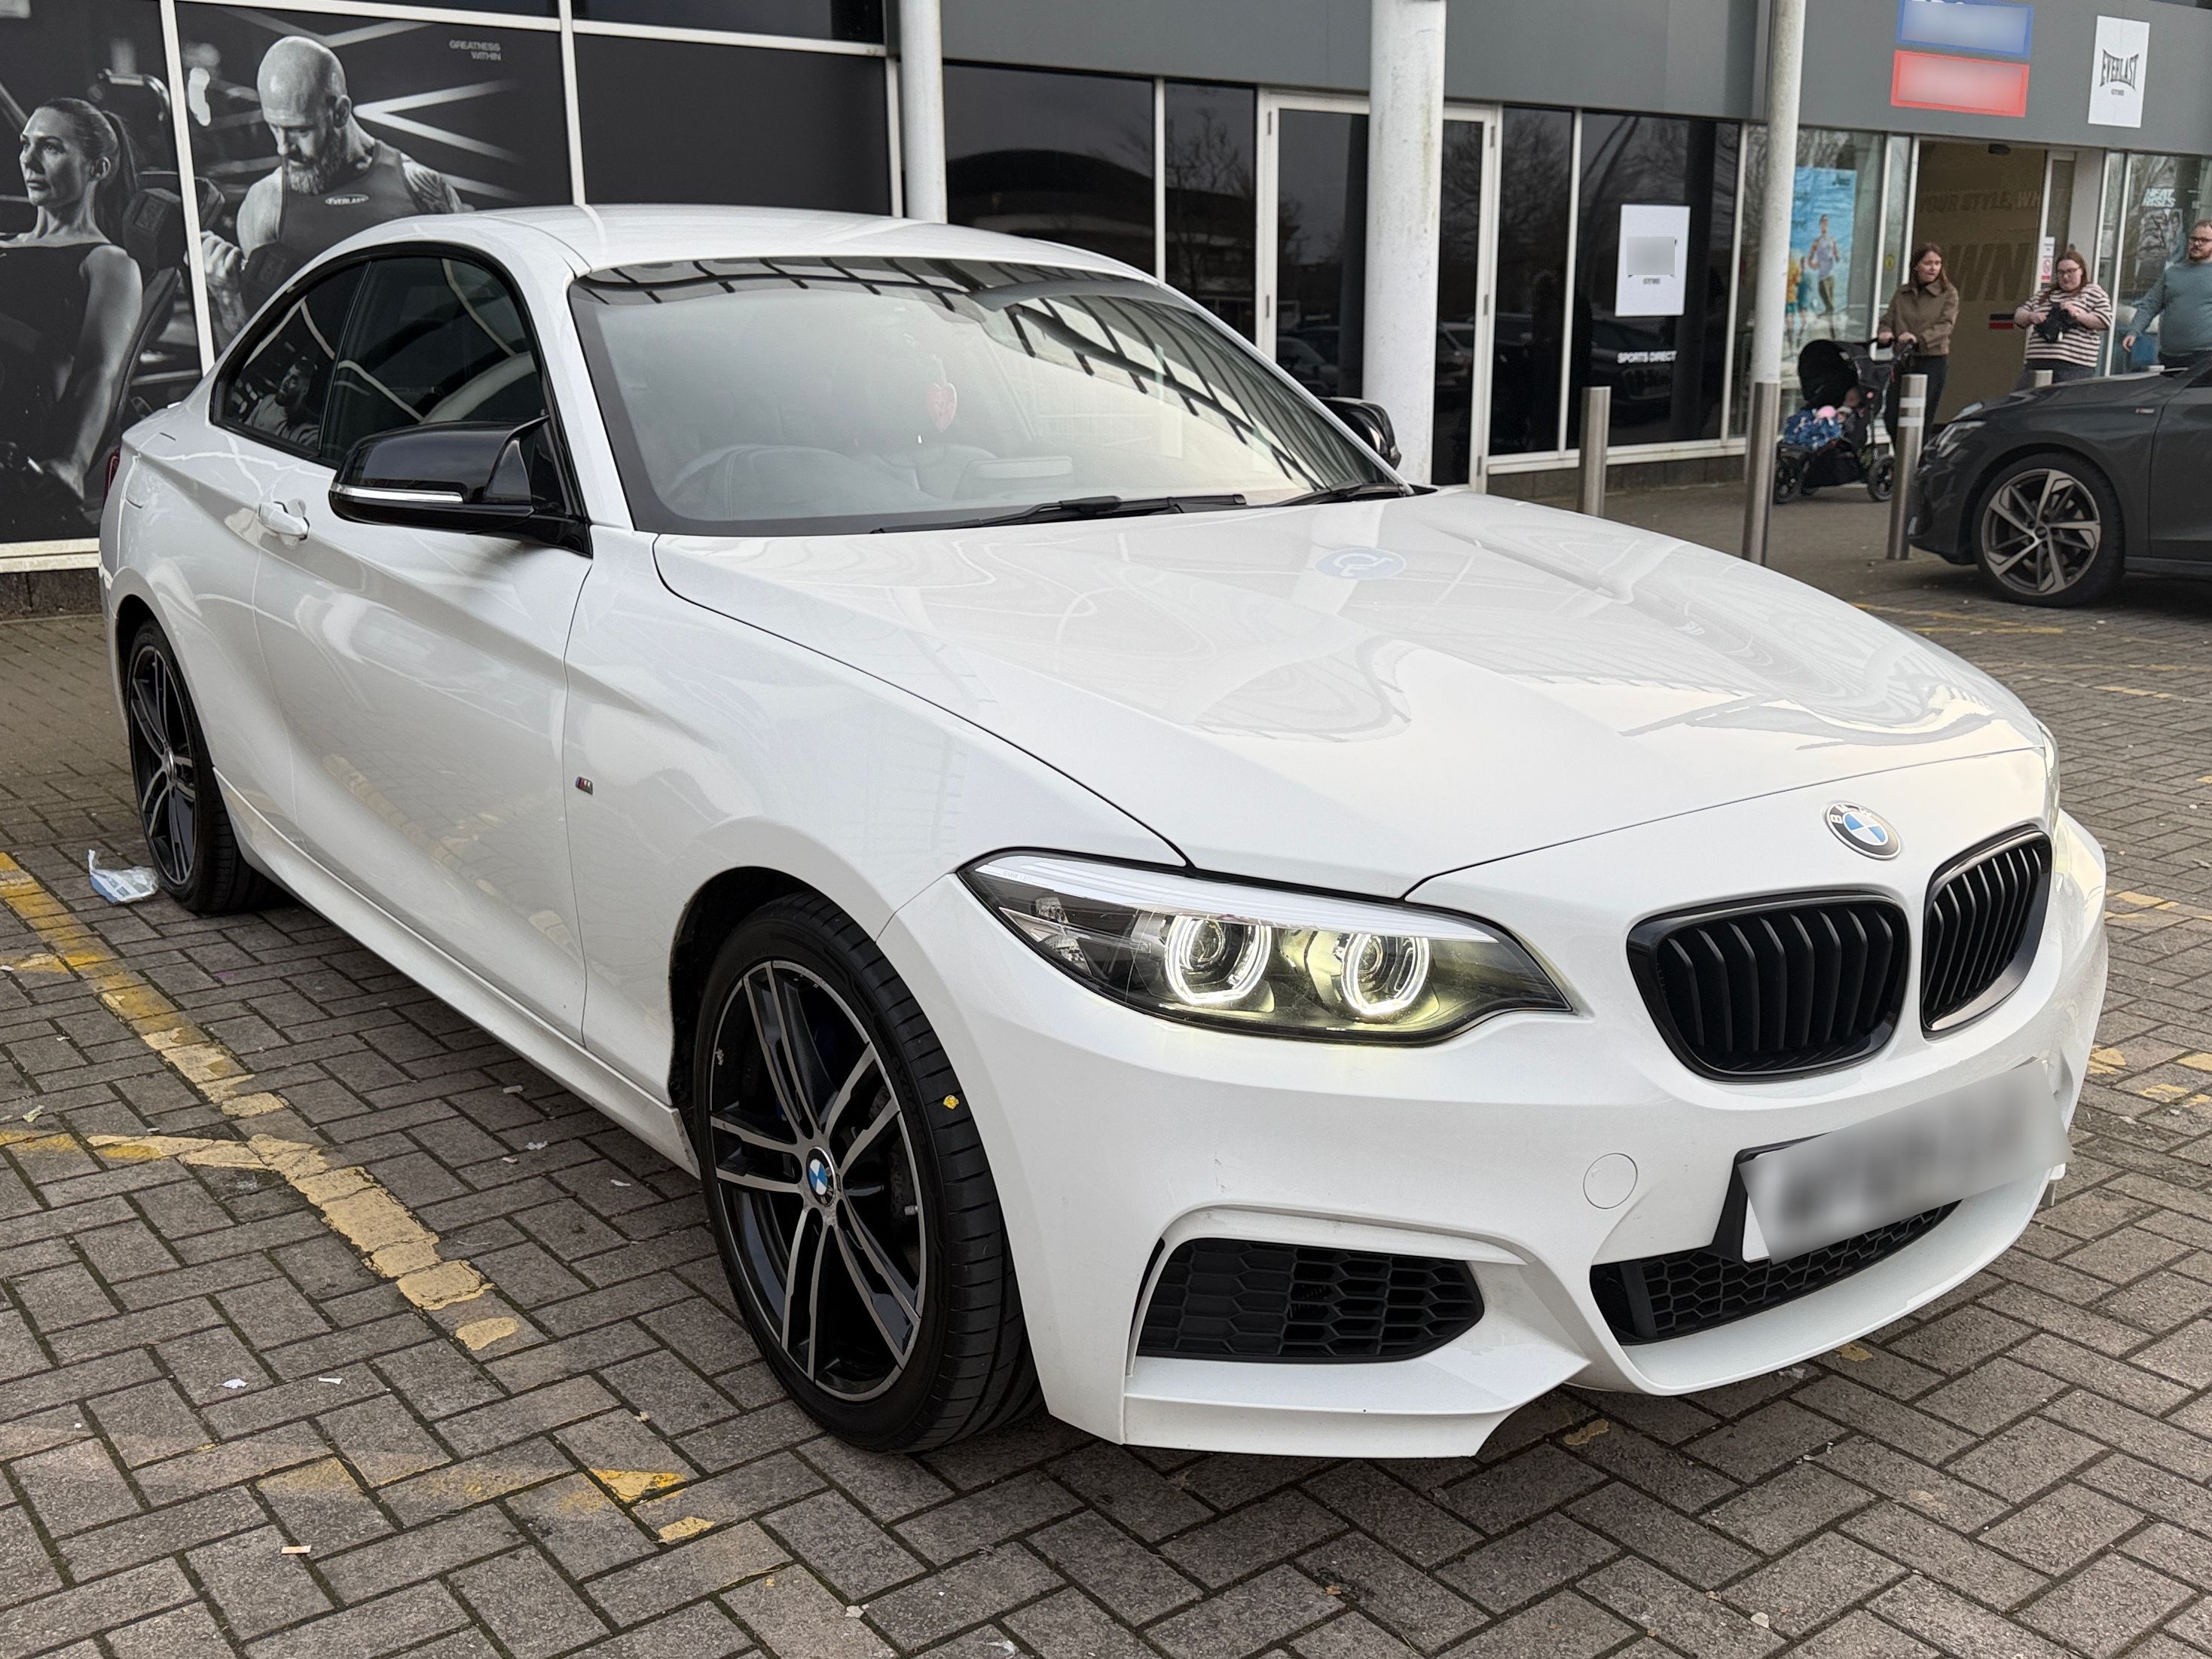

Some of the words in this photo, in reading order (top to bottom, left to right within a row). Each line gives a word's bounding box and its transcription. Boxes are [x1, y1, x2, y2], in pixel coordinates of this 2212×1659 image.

[449, 40, 501, 52] GREATNESS
[470, 51, 501, 61] WITHIN
[1617, 352, 1648, 364] SPORTS
[1649, 350, 1677, 362] DIRECT
